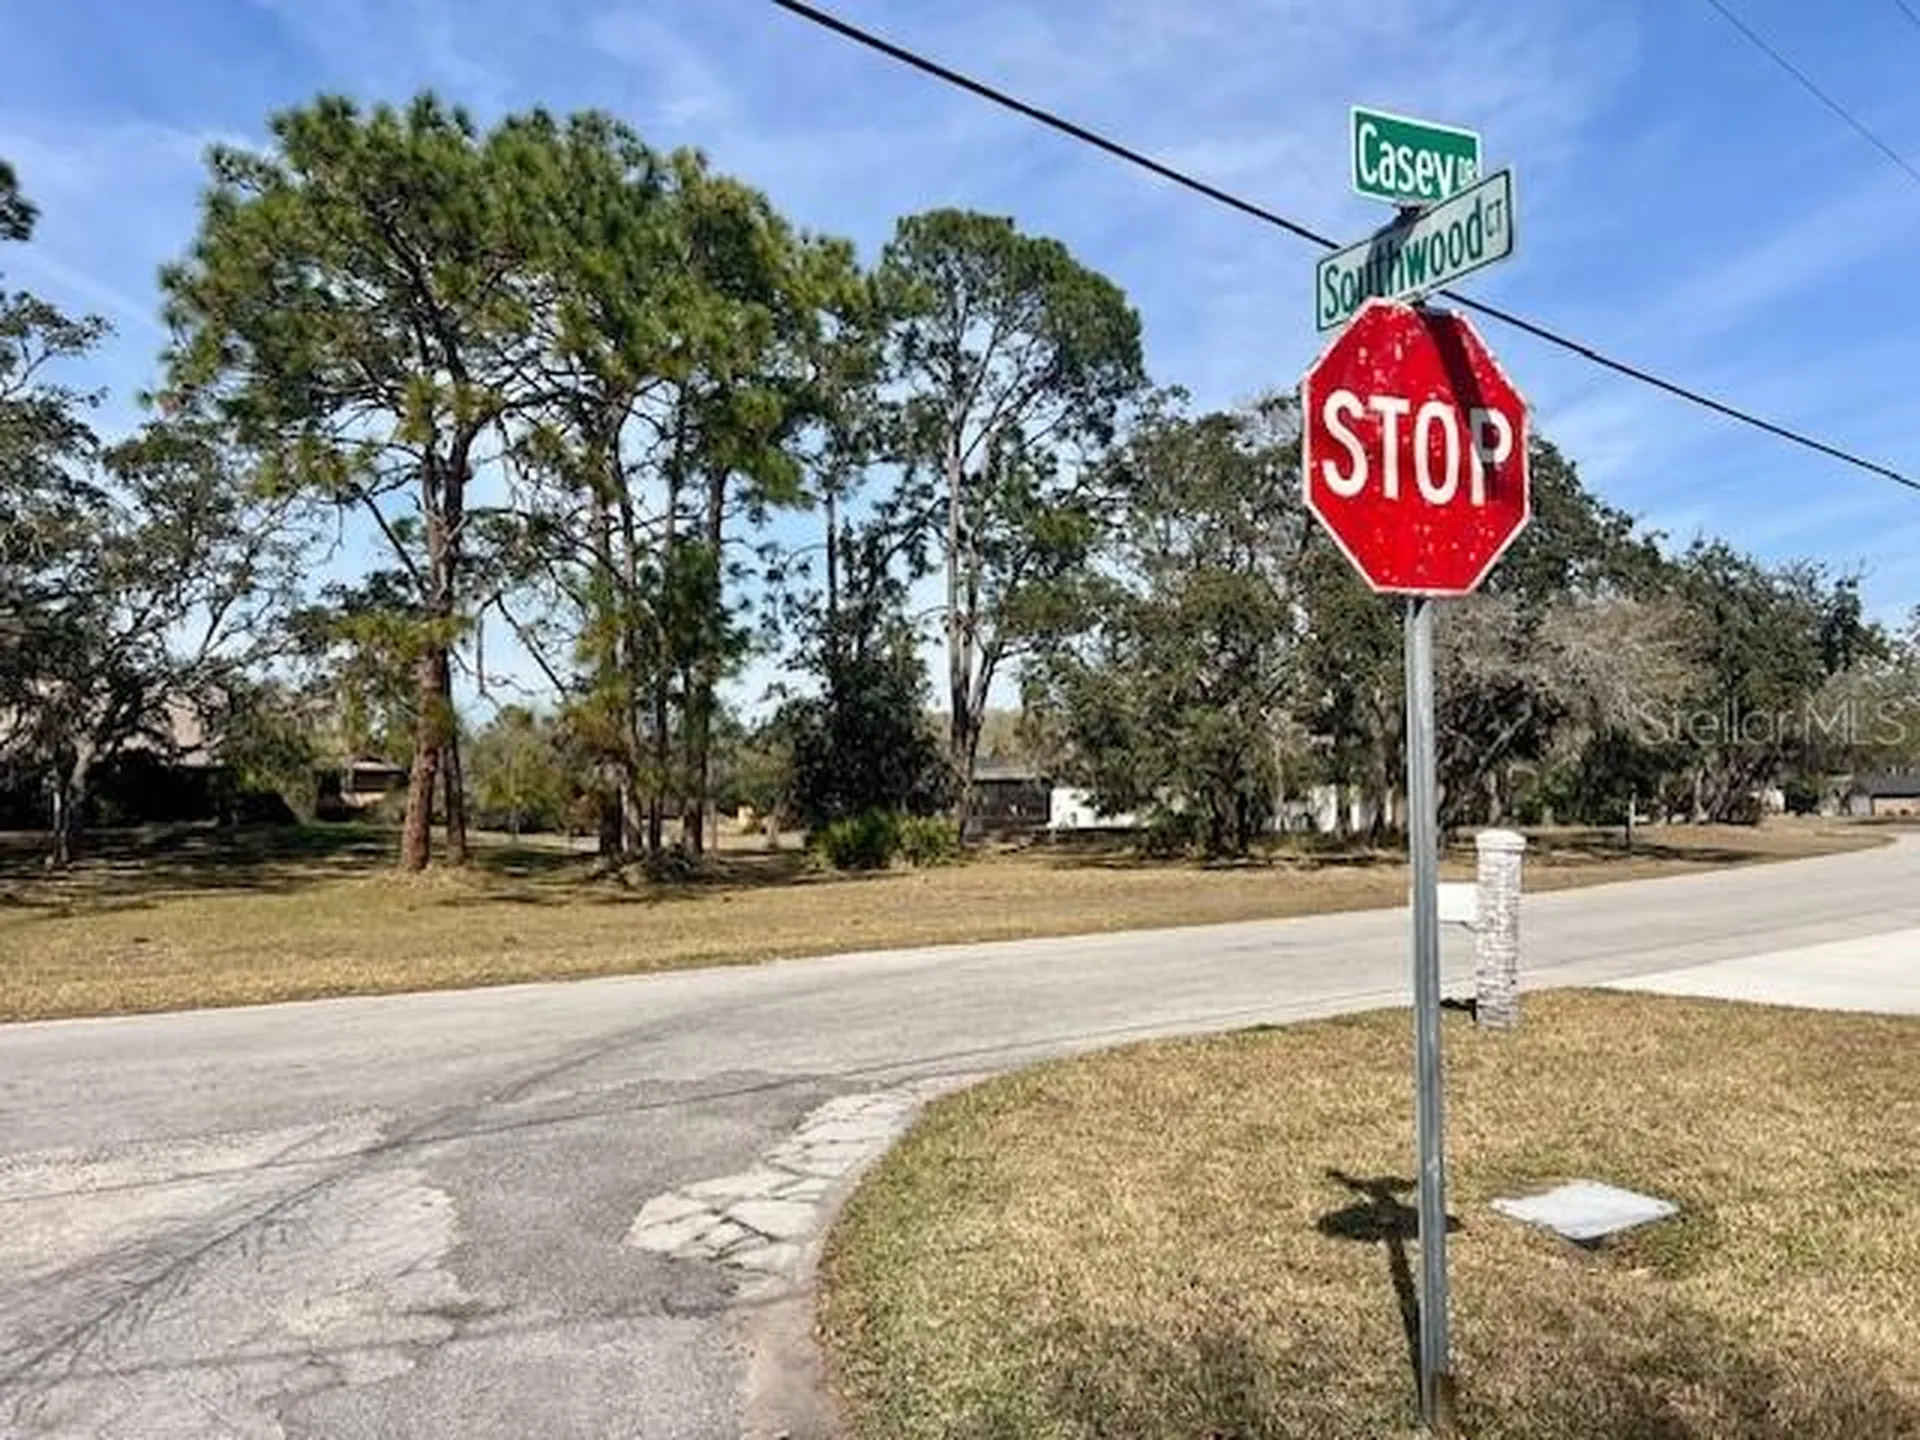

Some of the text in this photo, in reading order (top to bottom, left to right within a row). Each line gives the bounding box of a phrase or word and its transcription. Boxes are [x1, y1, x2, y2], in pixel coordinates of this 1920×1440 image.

[1358, 122, 1453, 198] Casey
[1323, 197, 1503, 320] Southwood CT
[1321, 388, 1513, 507] STOP
